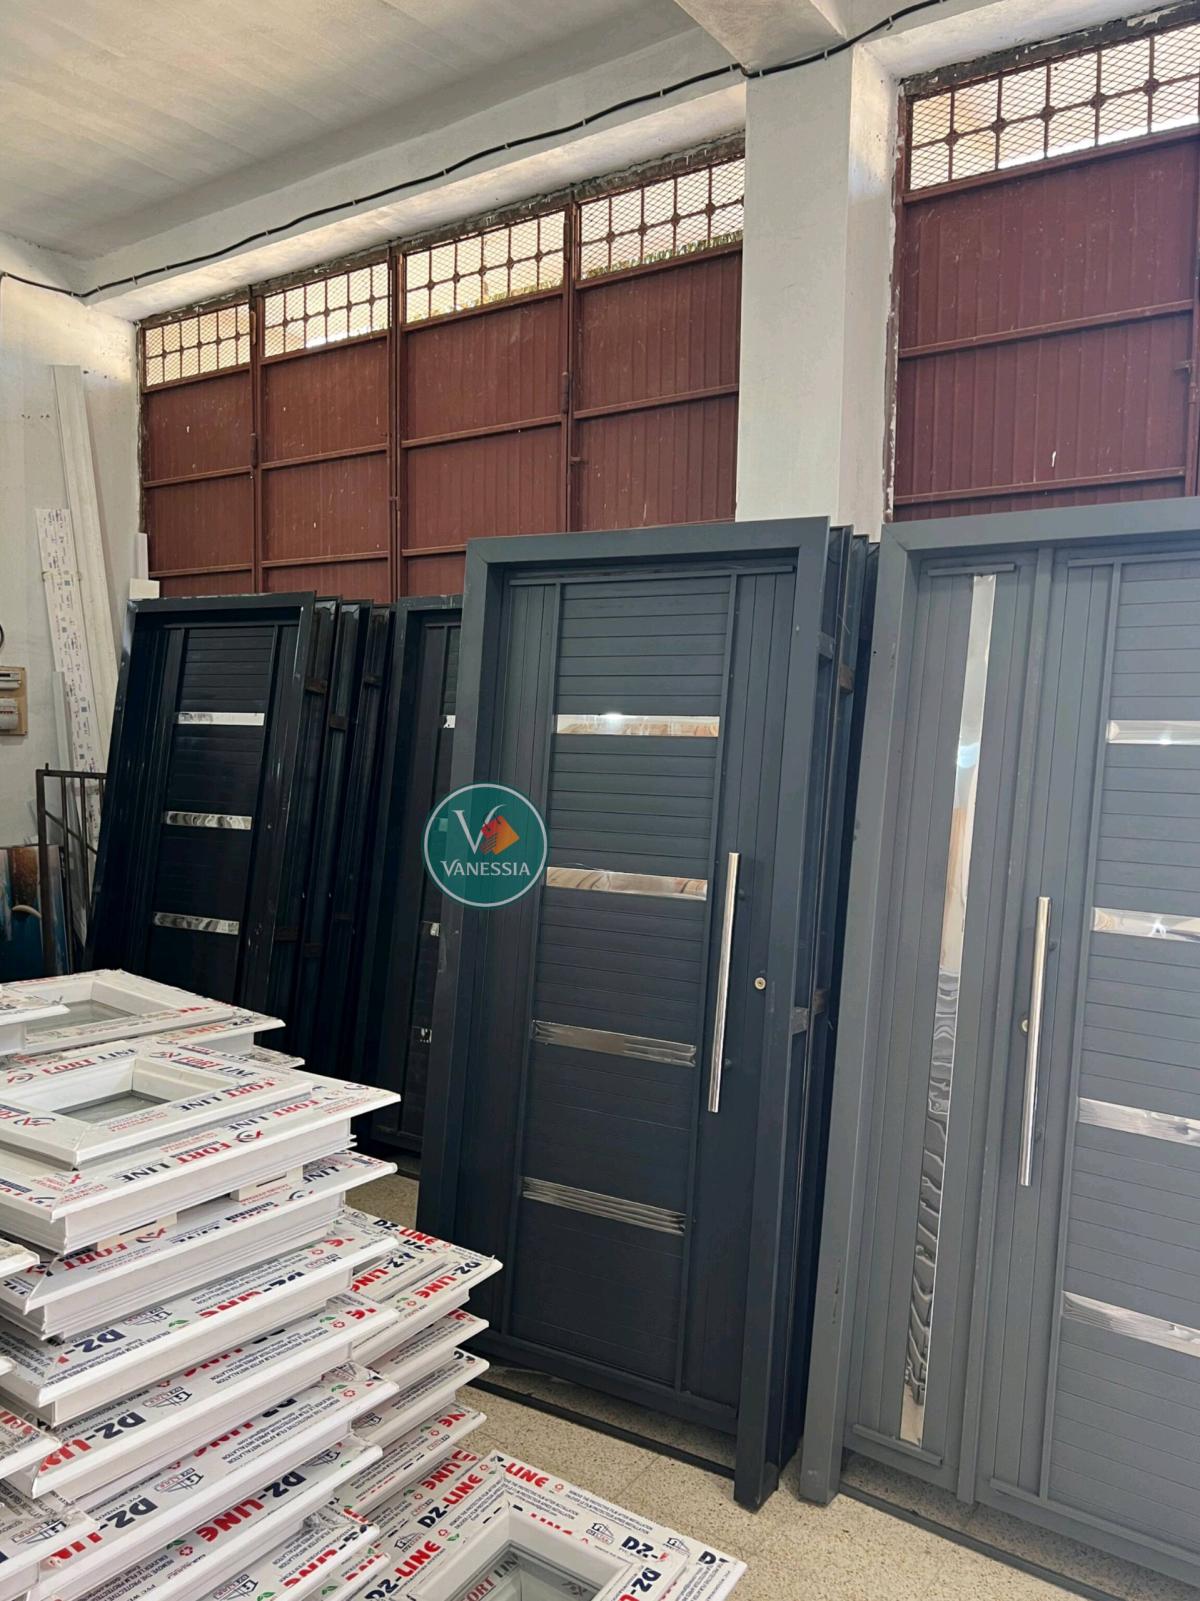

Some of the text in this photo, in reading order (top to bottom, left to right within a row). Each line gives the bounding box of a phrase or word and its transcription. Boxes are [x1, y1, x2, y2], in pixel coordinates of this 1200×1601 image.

[180, 1078, 277, 1112] FORT LINE
[272, 1099, 320, 1117] FORT
[227, 1115, 269, 1131] LINE
[176, 1141, 233, 1165] FORT
[120, 1162, 171, 1183] LINE
[63, 1243, 128, 1272] FORT
[414, 1260, 482, 1299] DZ-LINE
[220, 1439, 255, 1462] INSTALLATION
[226, 1442, 261, 1465] INSTALLATION
[196, 1471, 307, 1542] DZ-LINE
[417, 1474, 484, 1529] DZ-LINE
[365, 1540, 442, 1600] DZ-LINE
[462, 1576, 497, 1601] ORT
